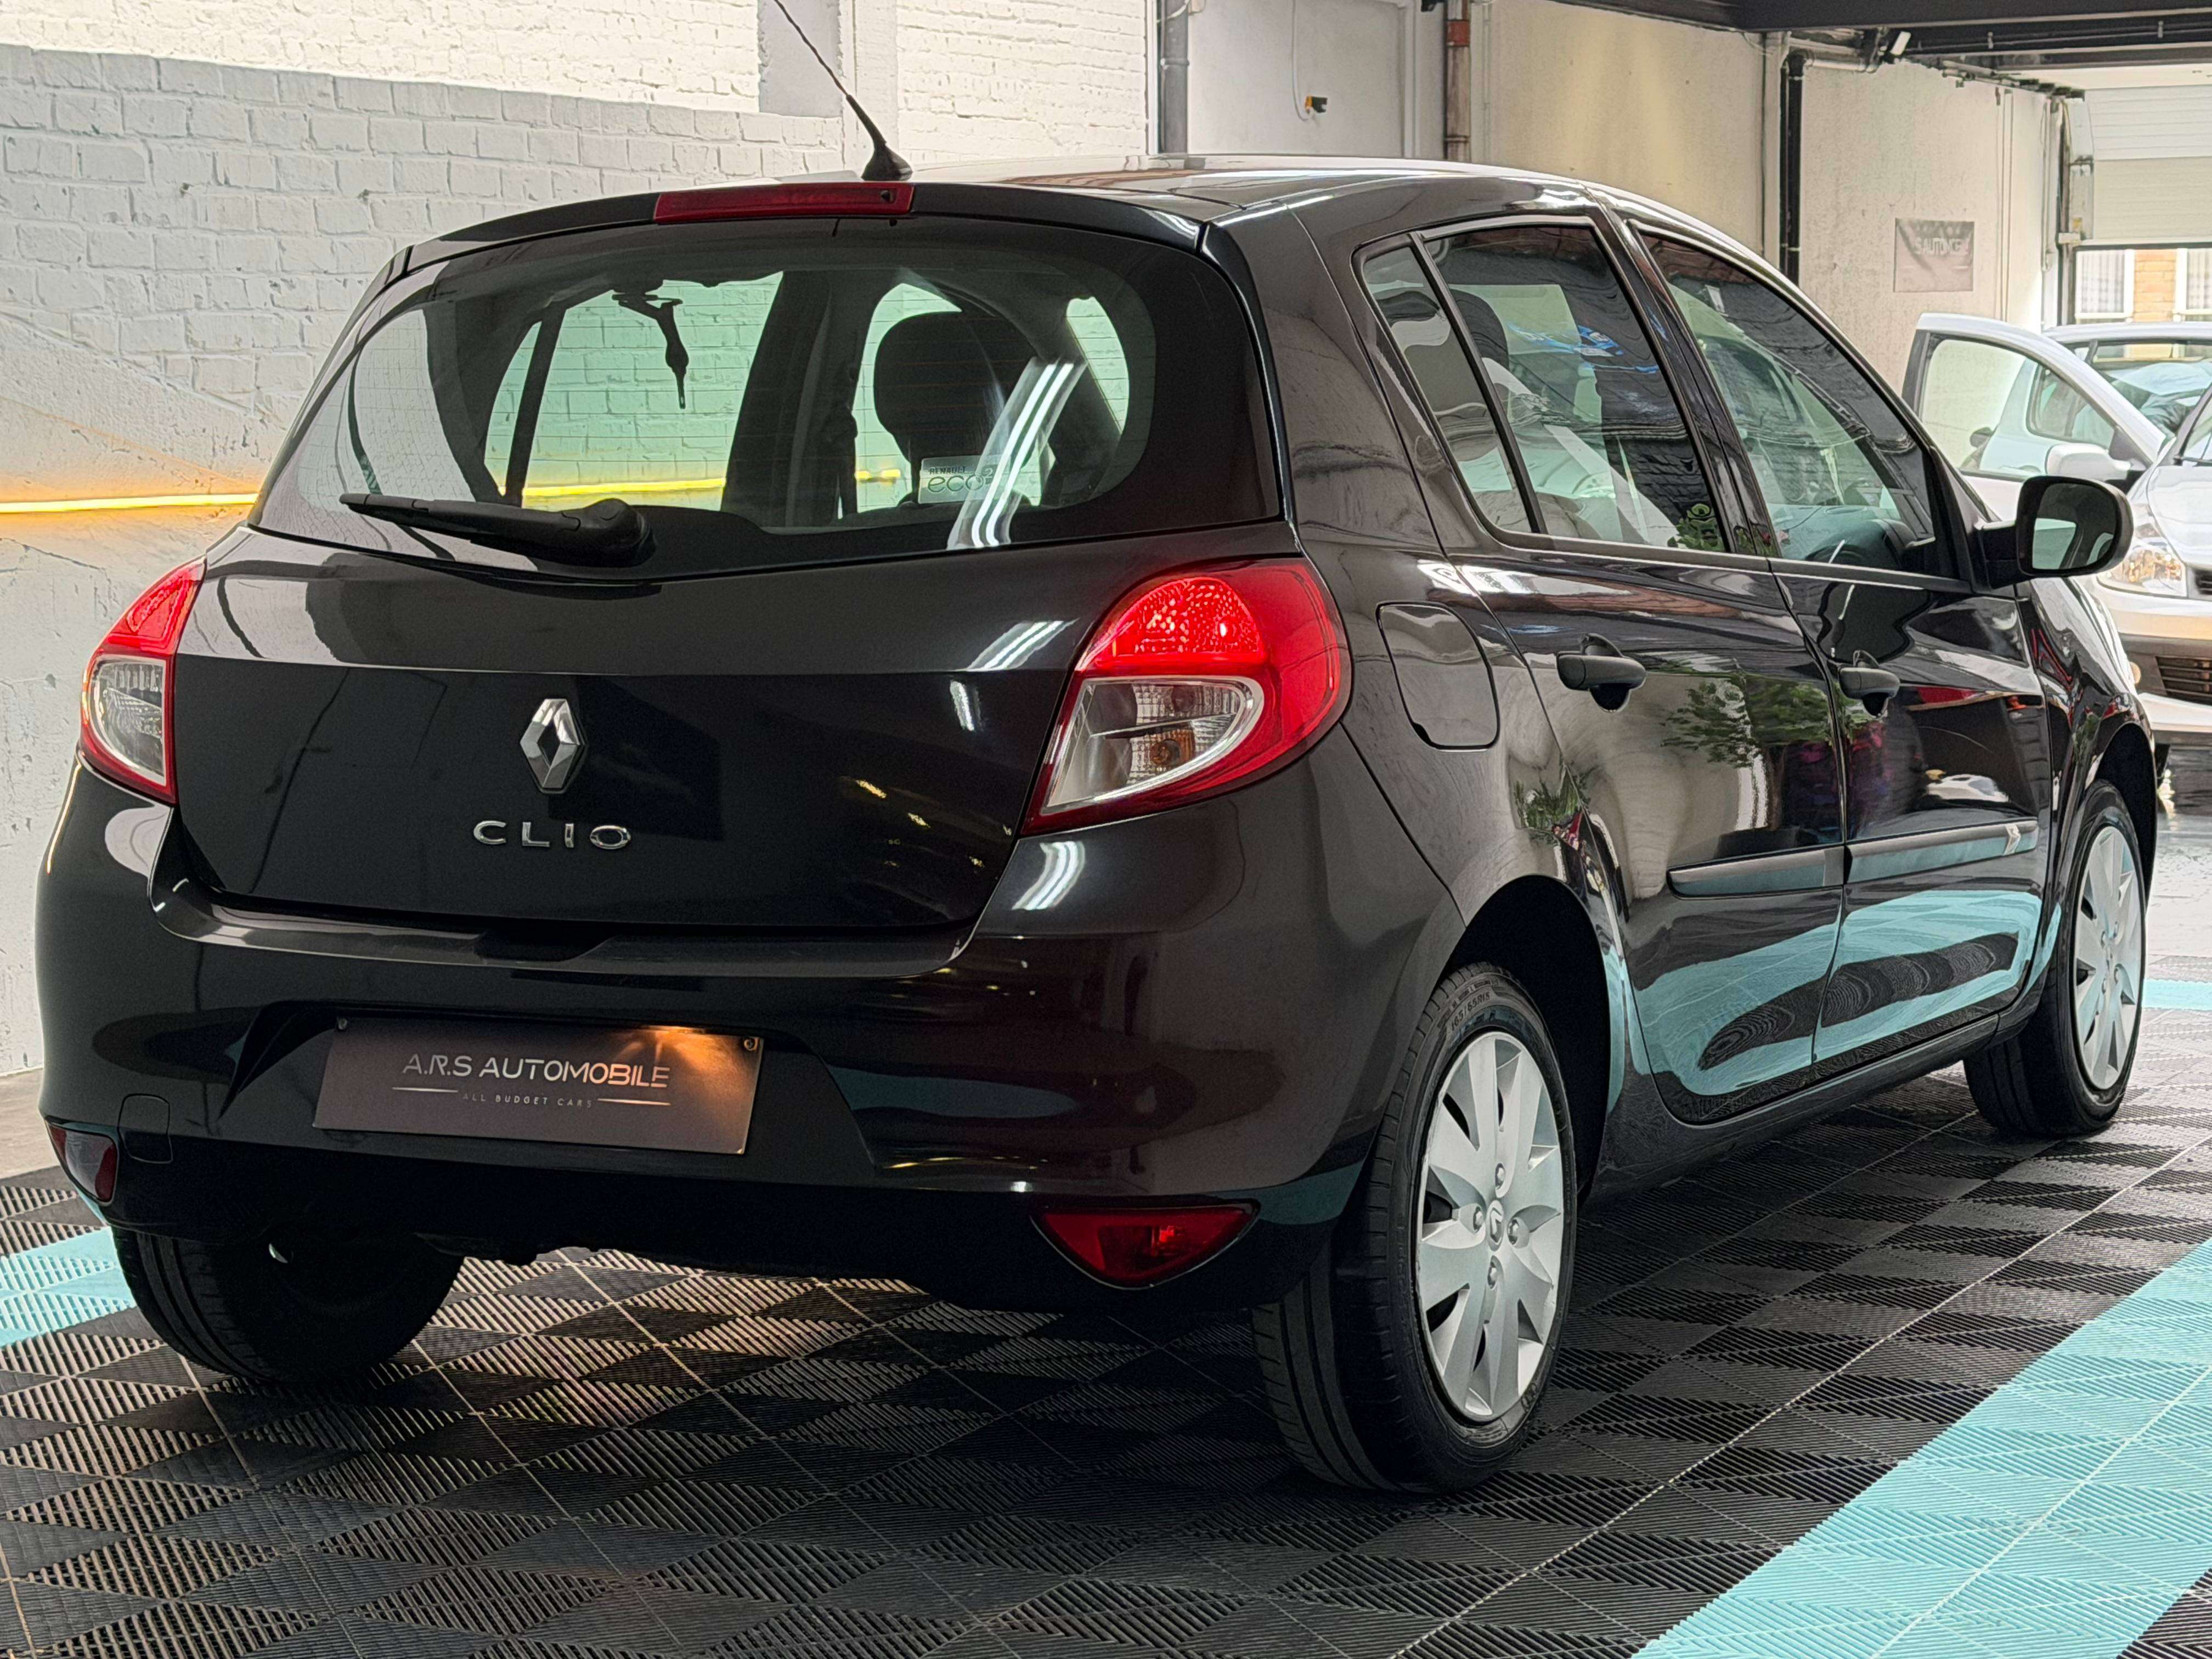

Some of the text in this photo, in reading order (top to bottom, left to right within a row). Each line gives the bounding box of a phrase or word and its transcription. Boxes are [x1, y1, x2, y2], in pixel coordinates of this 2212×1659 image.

[929, 466, 966, 475] RENAULT
[473, 820, 631, 850] CLIO
[402, 1053, 671, 1088] A.R.S AUTOMOBILE
[462, 1092, 592, 1109] ALL BUDGET CARS
